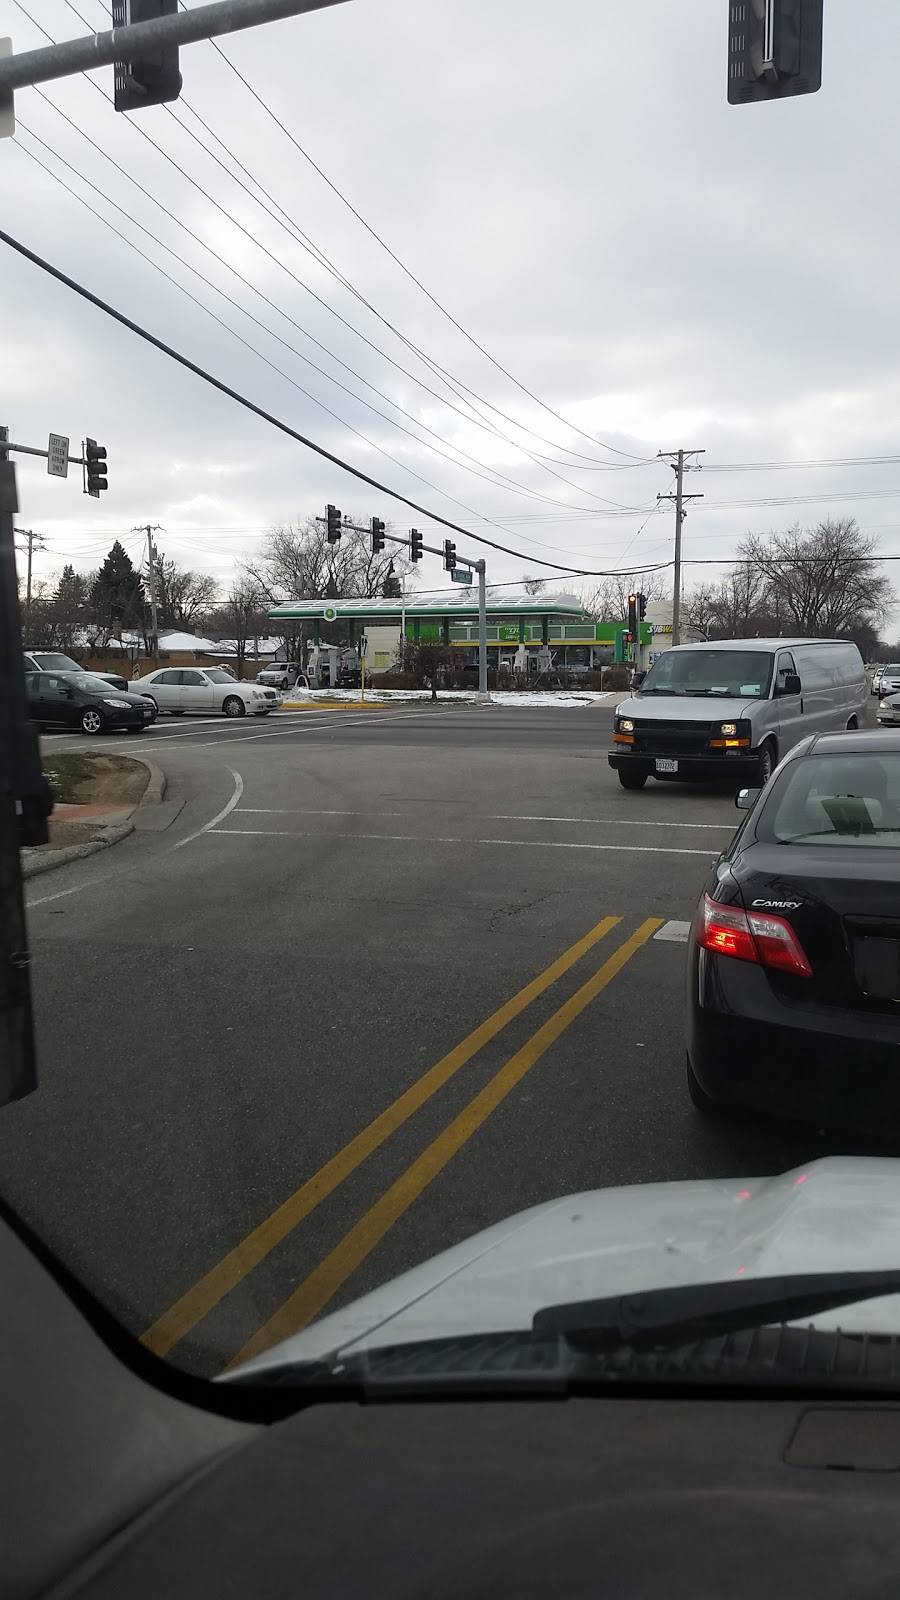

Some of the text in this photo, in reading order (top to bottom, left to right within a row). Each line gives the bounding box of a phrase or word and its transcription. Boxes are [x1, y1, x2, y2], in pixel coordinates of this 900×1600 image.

[51, 438, 67, 448] LEFT ON
[647, 625, 673, 634] SUBWA
[752, 899, 803, 909] CAMRY
